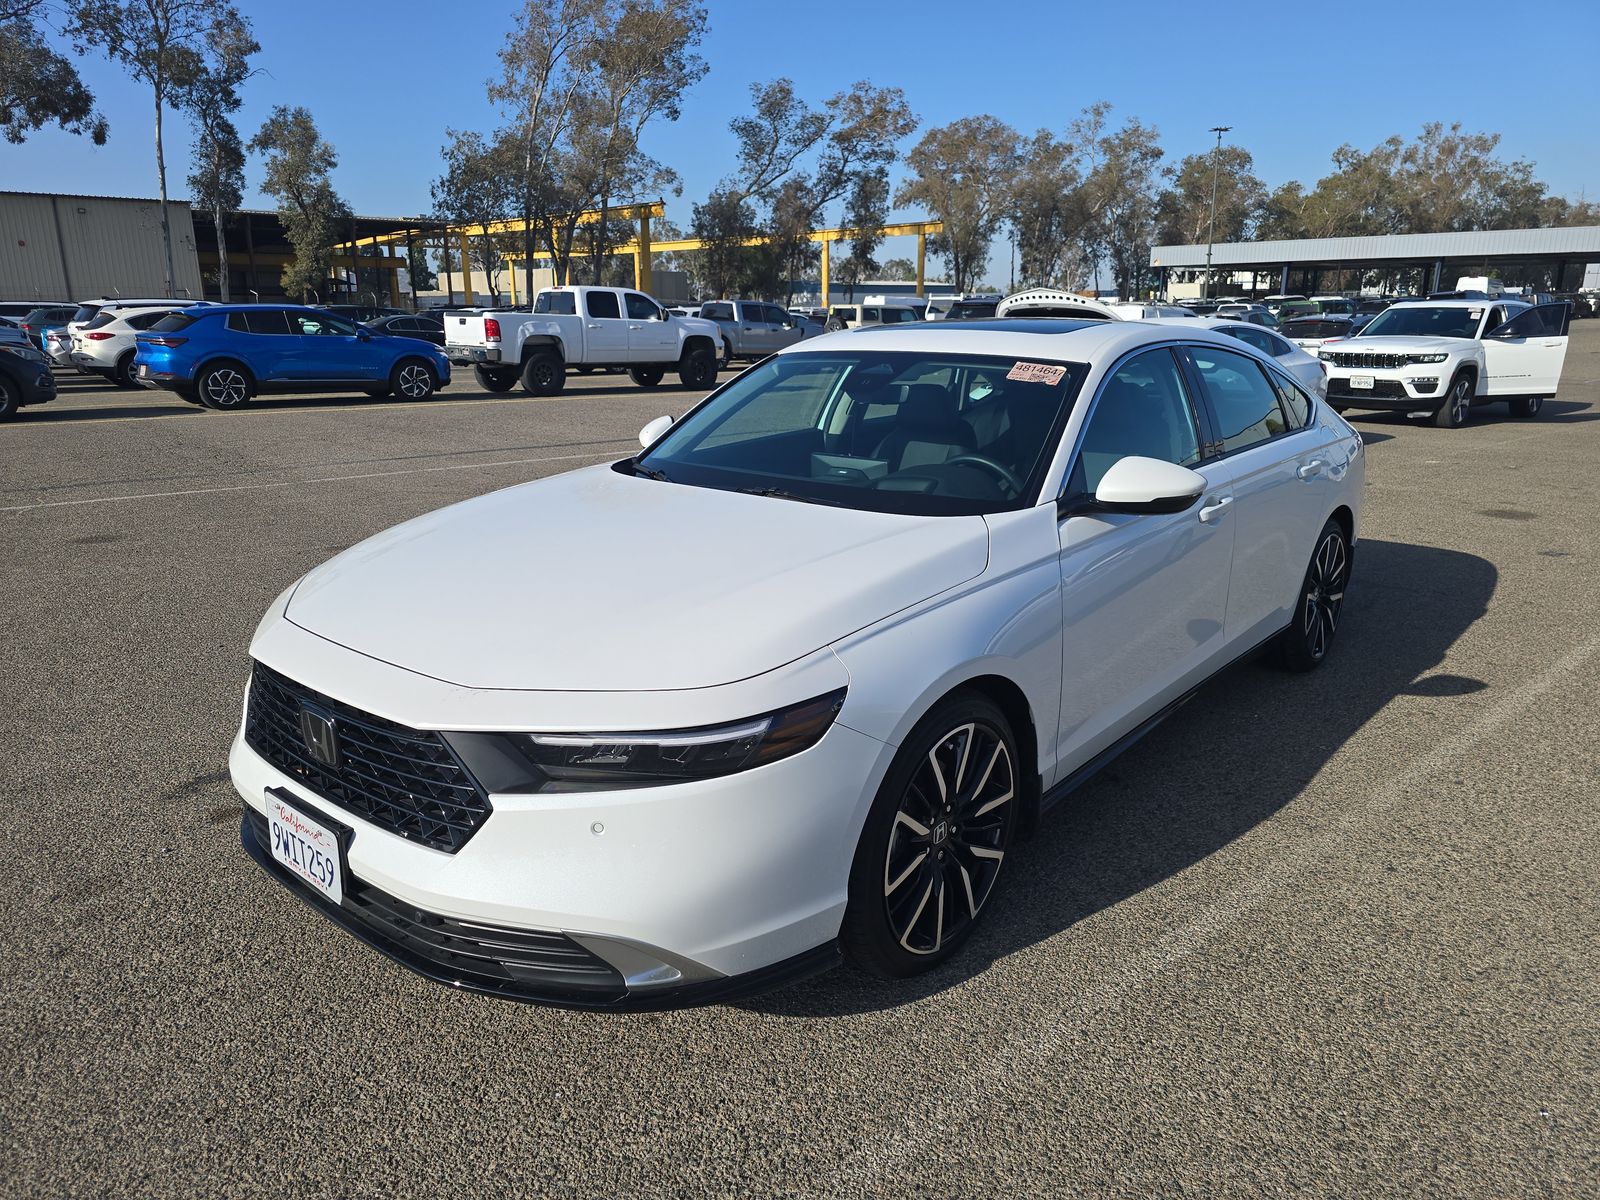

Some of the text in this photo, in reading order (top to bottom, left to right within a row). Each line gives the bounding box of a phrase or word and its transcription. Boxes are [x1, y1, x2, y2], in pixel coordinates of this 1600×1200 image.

[1015, 364, 1065, 376] 4814647
[280, 806, 323, 842] California
[273, 821, 335, 888] 9WIT259
